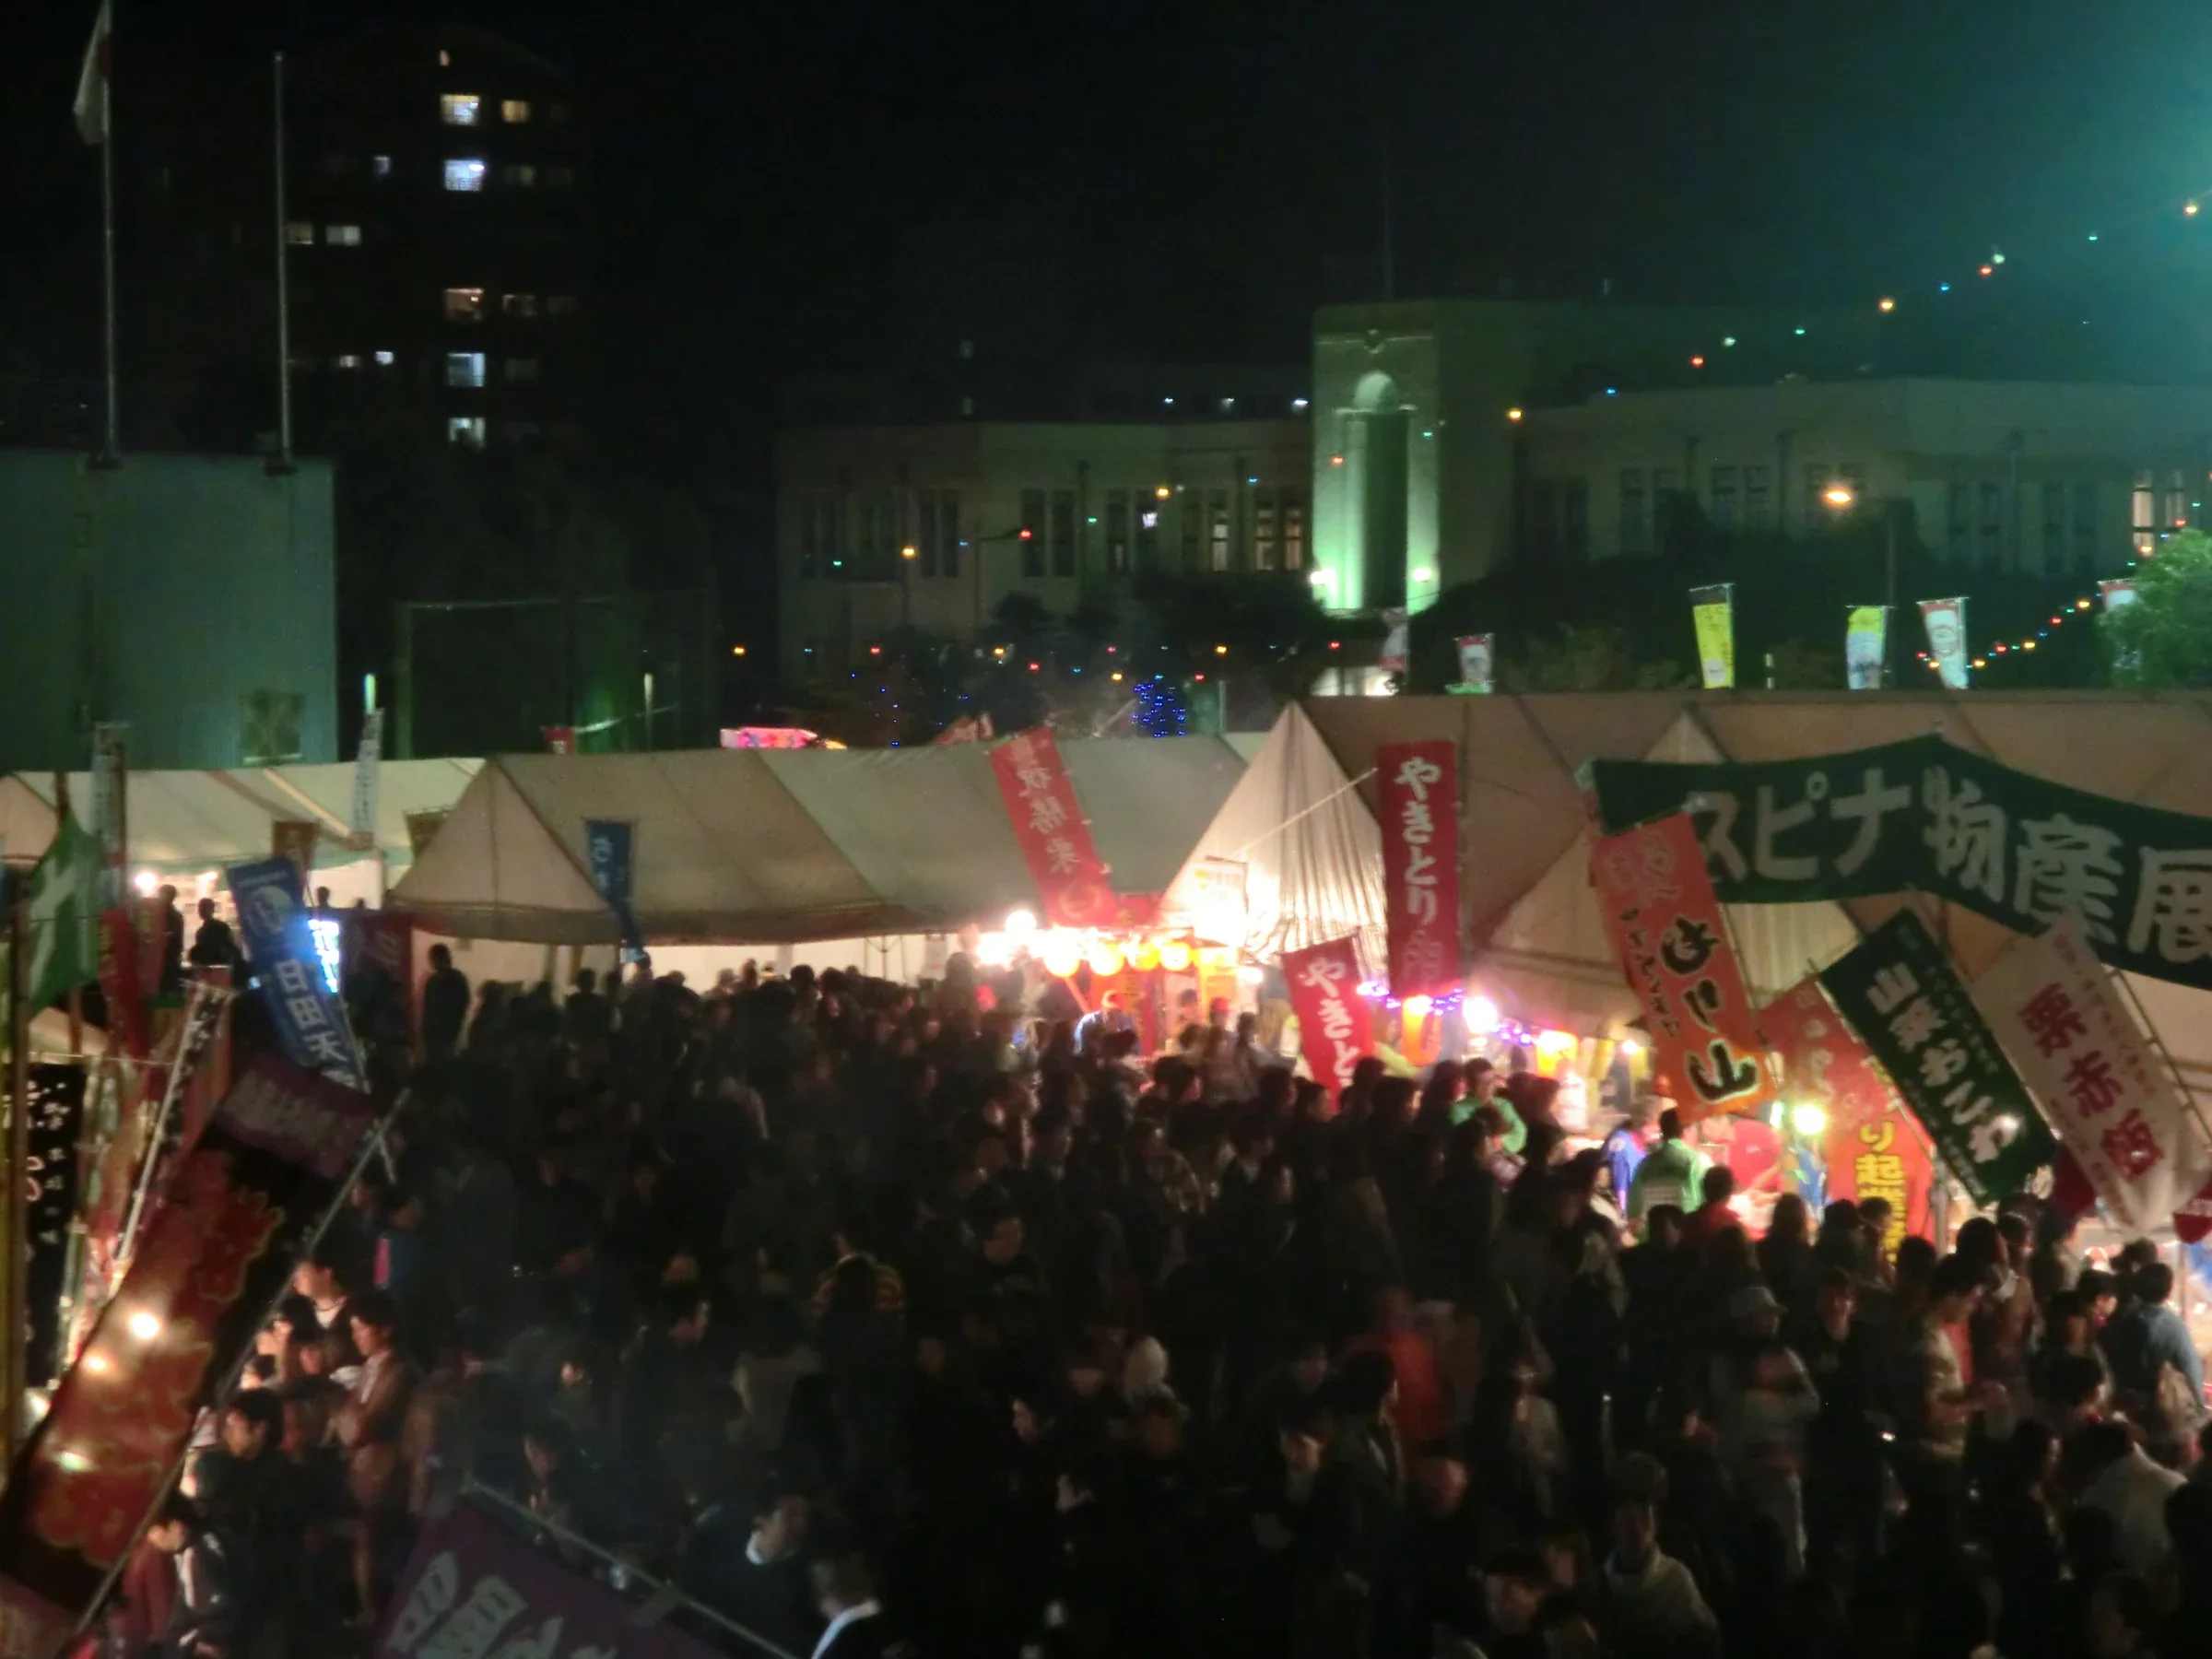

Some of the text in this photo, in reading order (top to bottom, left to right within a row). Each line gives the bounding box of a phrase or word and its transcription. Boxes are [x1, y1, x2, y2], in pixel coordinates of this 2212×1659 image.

[1394, 754, 1441, 927] やきとり
[1687, 766, 2212, 964] スピナ物産展
[1865, 961, 2018, 1164] 山菜おこわ
